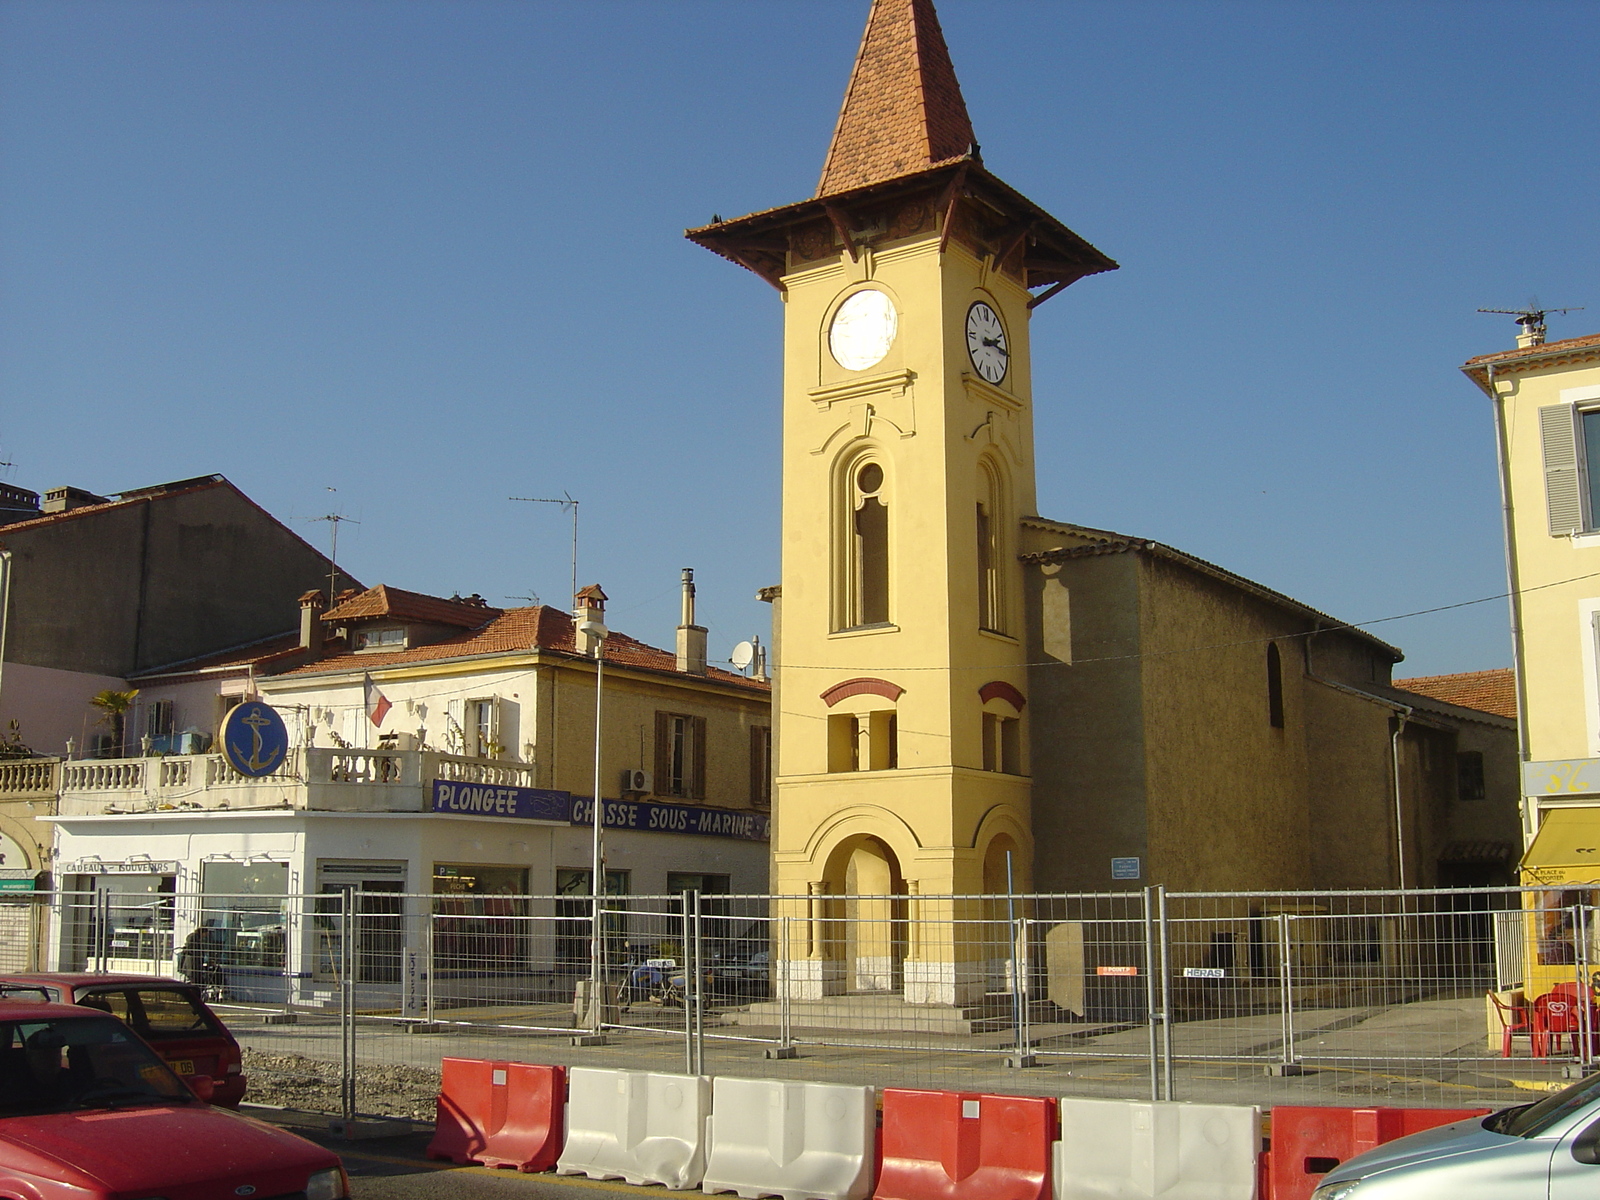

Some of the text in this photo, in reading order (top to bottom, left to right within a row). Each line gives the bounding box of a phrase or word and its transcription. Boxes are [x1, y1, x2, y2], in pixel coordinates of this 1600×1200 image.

[437, 784, 518, 815] PLONGEE
[1186, 968, 1222, 978] HERAS
[181, 1061, 193, 1074] 06
